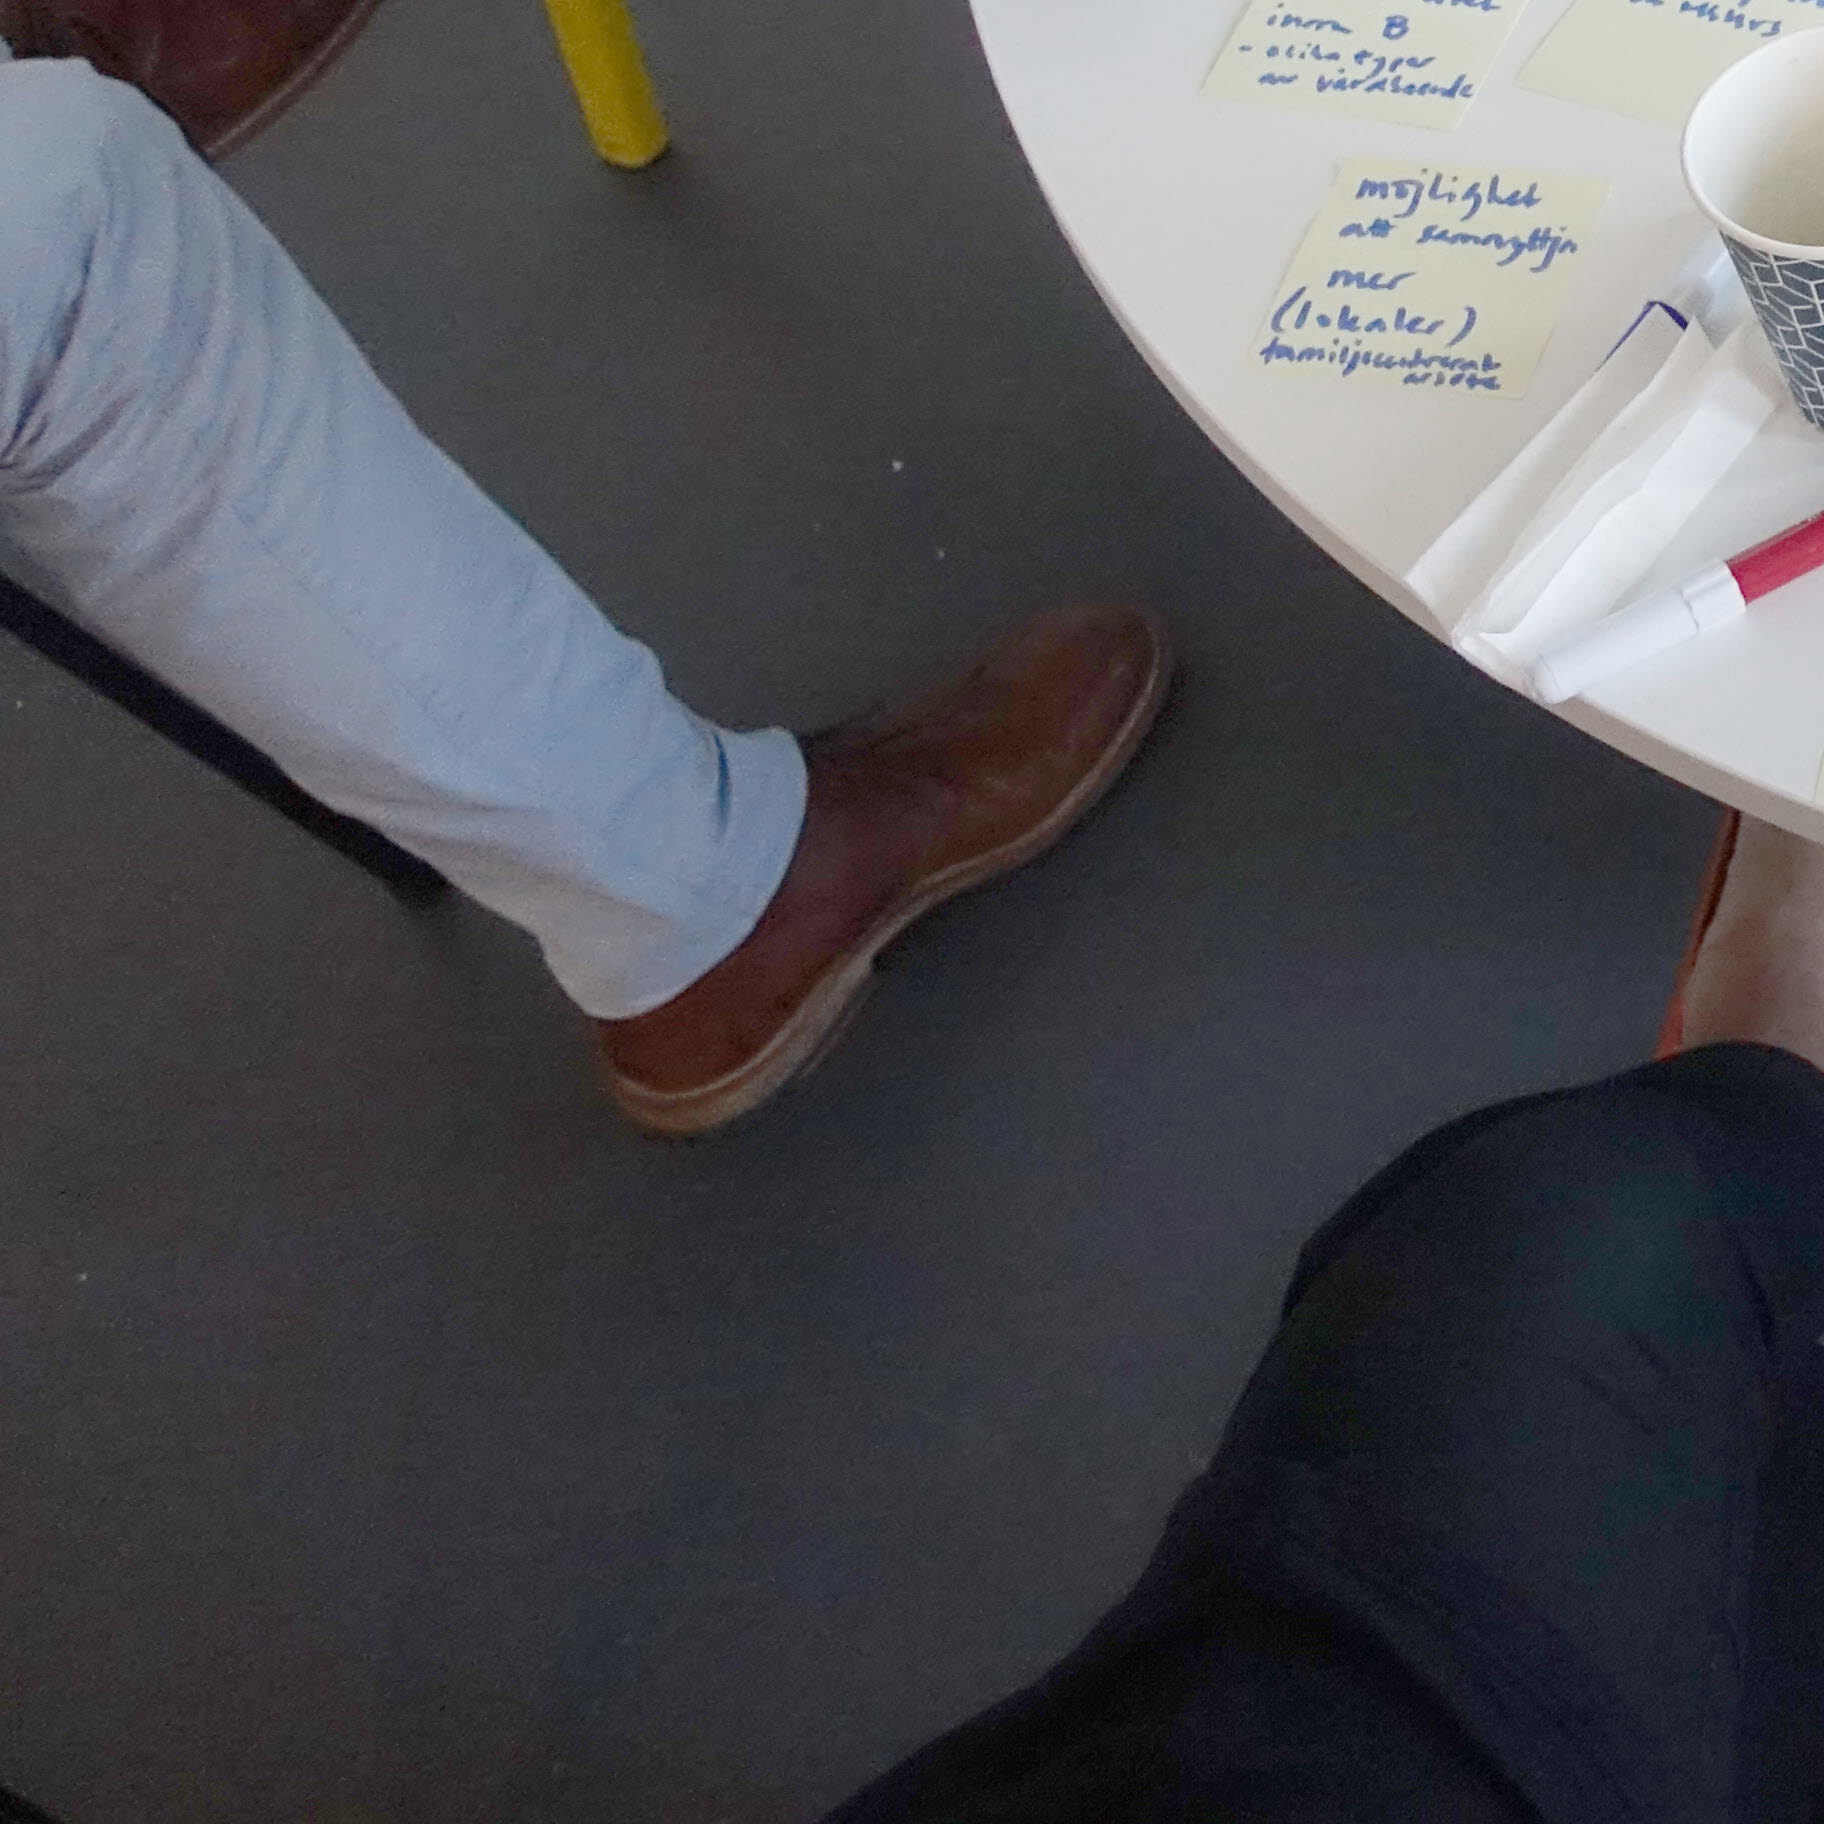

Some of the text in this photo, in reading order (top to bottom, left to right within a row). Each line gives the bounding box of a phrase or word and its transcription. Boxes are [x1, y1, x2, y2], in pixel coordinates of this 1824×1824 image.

[1354, 166, 1543, 222] möjlighet
[1338, 217, 1397, 239] att
[1326, 267, 1418, 290] mer
[1270, 285, 1478, 349] (lokaler)
